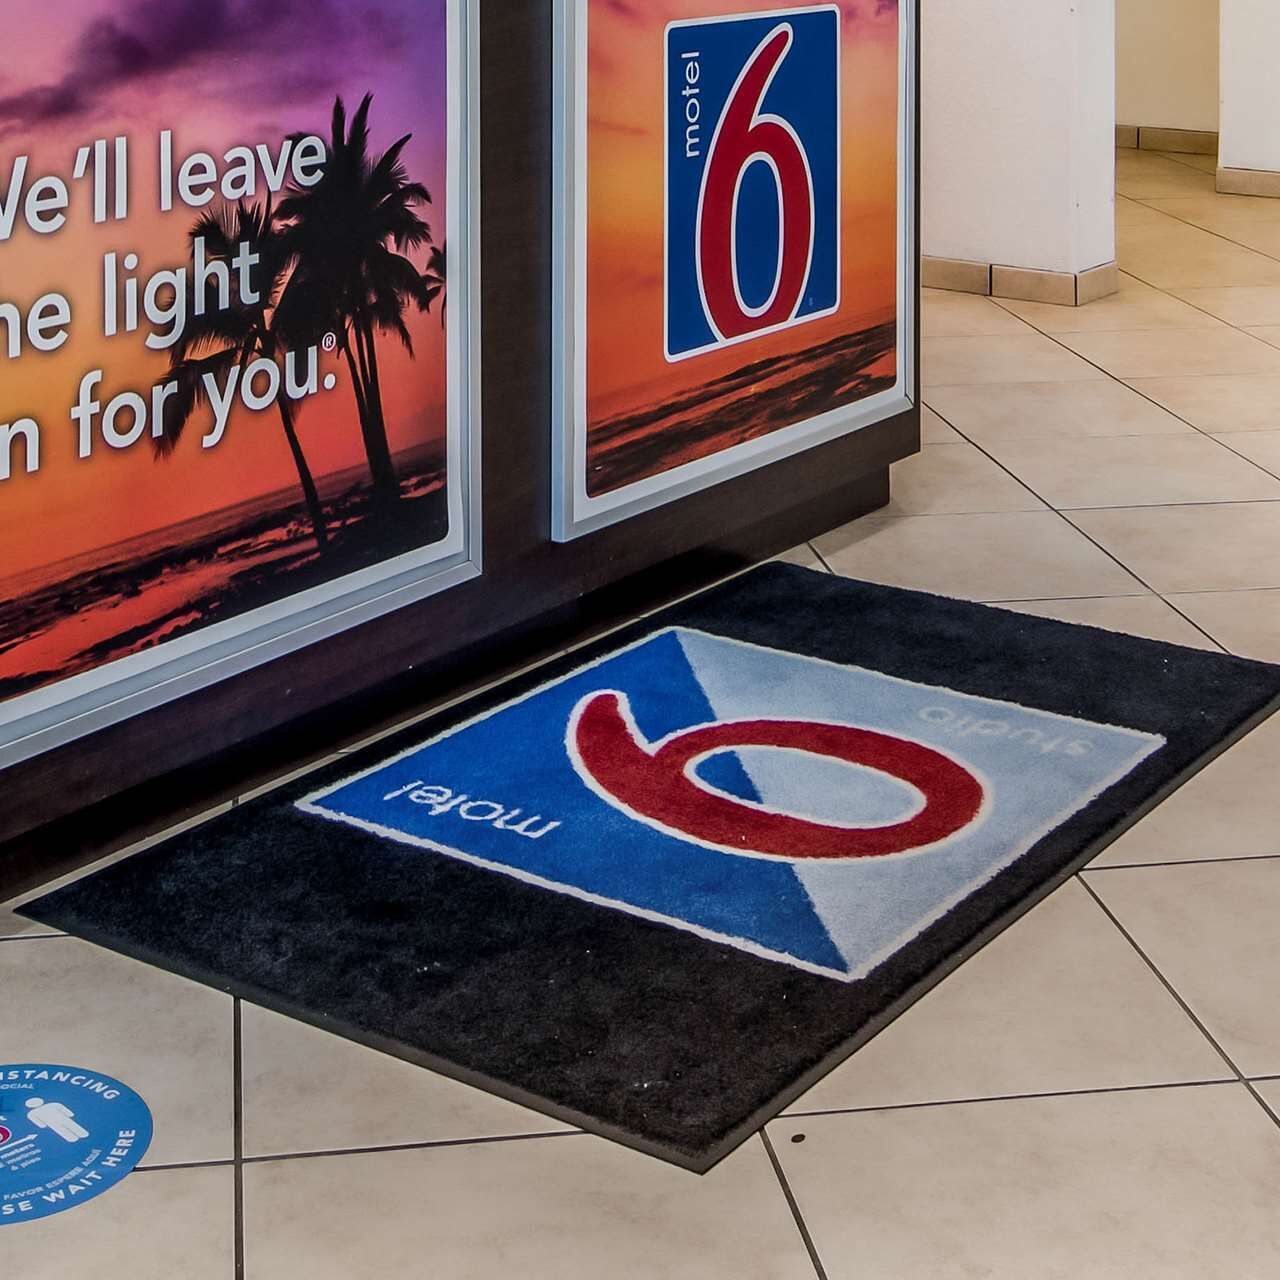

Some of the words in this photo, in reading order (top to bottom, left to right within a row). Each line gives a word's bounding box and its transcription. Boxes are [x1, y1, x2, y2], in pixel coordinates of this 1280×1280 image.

[160, 130, 327, 211] leave
[682, 51, 700, 158] motel
[695, 22, 815, 344] 6
[104, 236, 260, 349] light
[71, 369, 179, 459] for
[385, 778, 563, 840] motel
[565, 688, 992, 863] 6
[3, 1186, 44, 1201] FAVOR
[46, 1166, 83, 1189] ESPERE
[42, 1170, 104, 1204] WAIT
[101, 1129, 136, 1167] HERE
